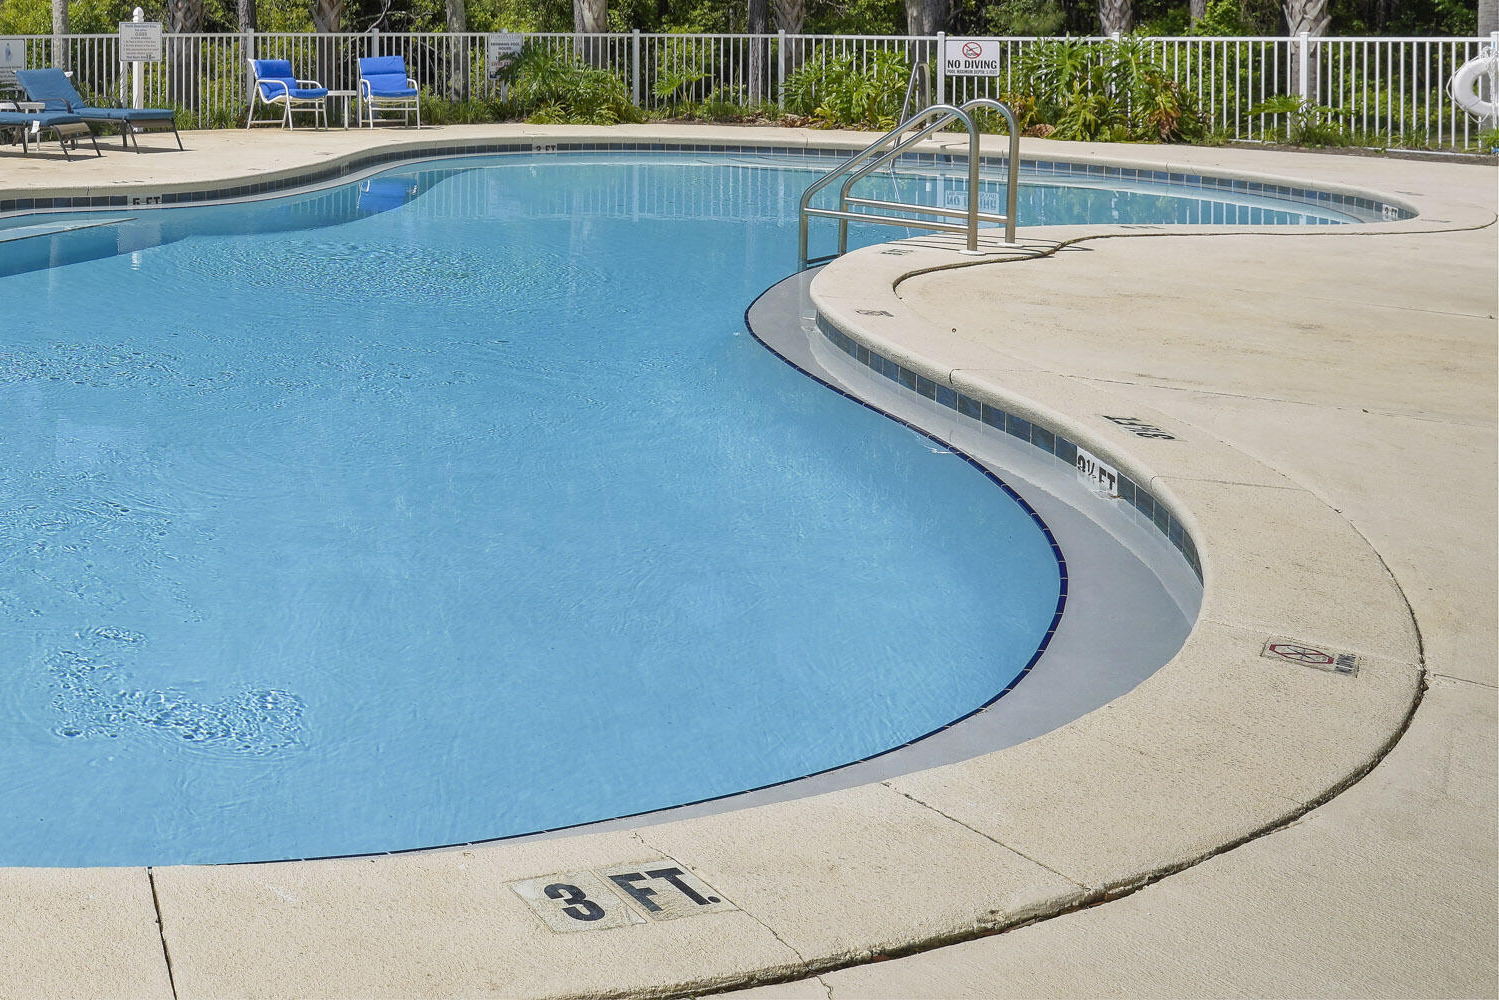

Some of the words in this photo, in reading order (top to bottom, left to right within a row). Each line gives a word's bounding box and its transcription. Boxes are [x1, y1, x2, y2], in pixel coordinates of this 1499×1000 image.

[947, 60, 961, 69] NO
[964, 60, 997, 69] DIVING
[146, 196, 160, 204] FT
[1099, 467, 1116, 490] FT
[544, 883, 606, 921] 3
[608, 867, 721, 912] FT.
